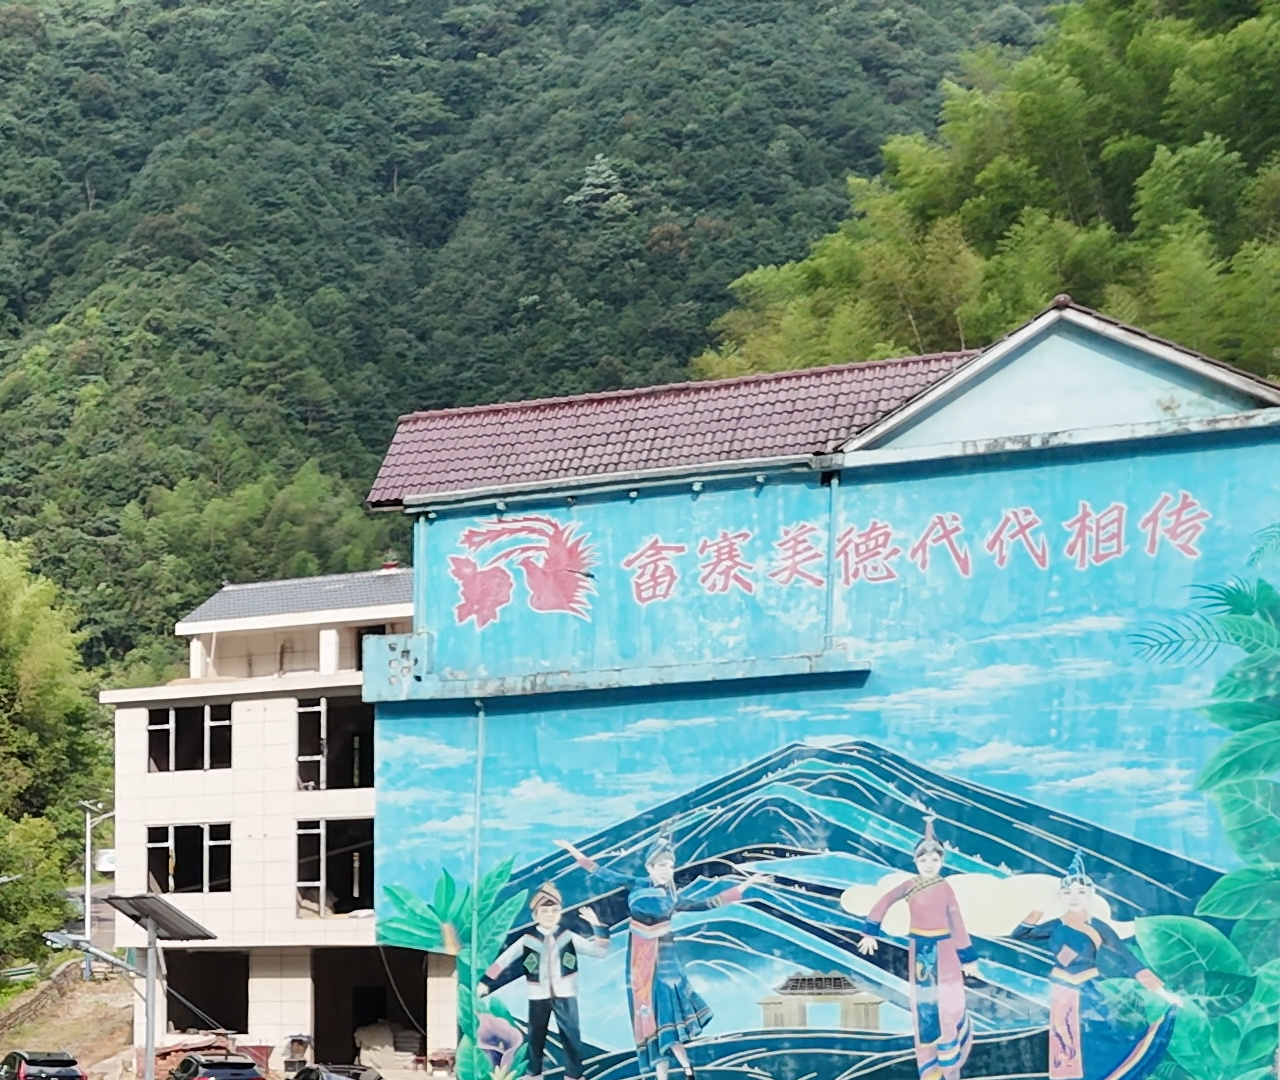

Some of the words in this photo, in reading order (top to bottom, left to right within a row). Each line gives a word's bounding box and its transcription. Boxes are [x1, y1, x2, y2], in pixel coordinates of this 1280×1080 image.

[621, 490, 1212, 606] 畲寨美德代代相传
